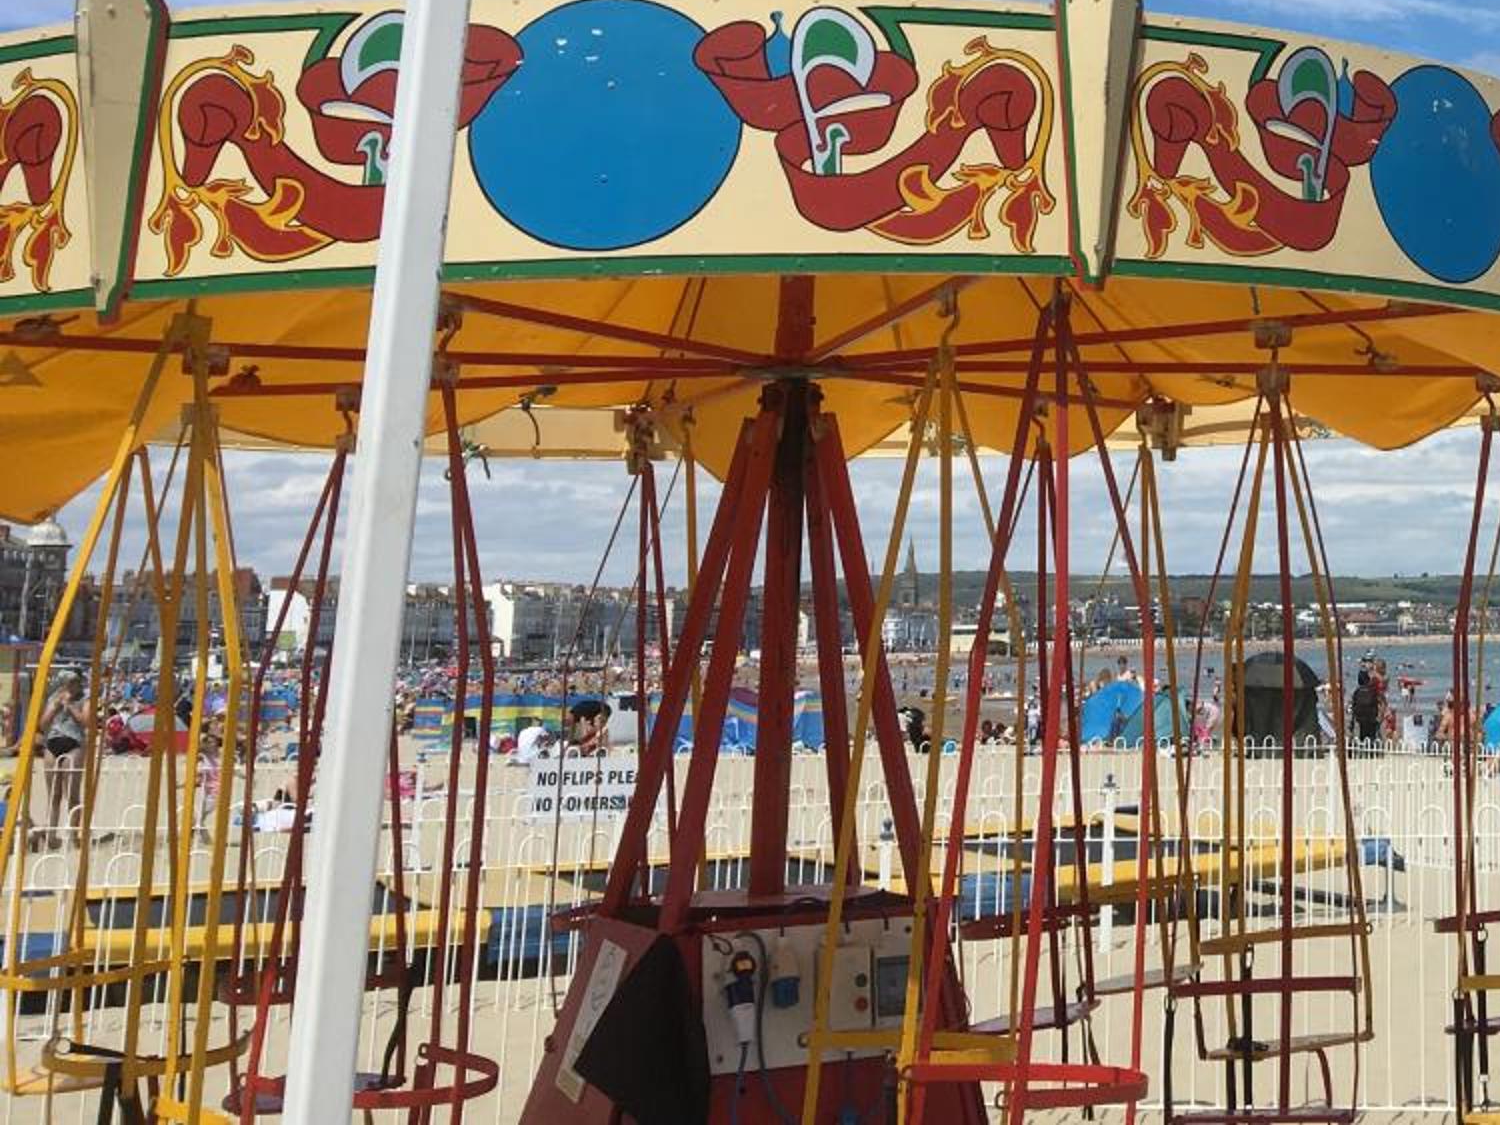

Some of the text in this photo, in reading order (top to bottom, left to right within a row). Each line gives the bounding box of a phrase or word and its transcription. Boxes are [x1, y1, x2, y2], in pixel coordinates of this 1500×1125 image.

[537, 770, 638, 786] NO FLIPS PLE
